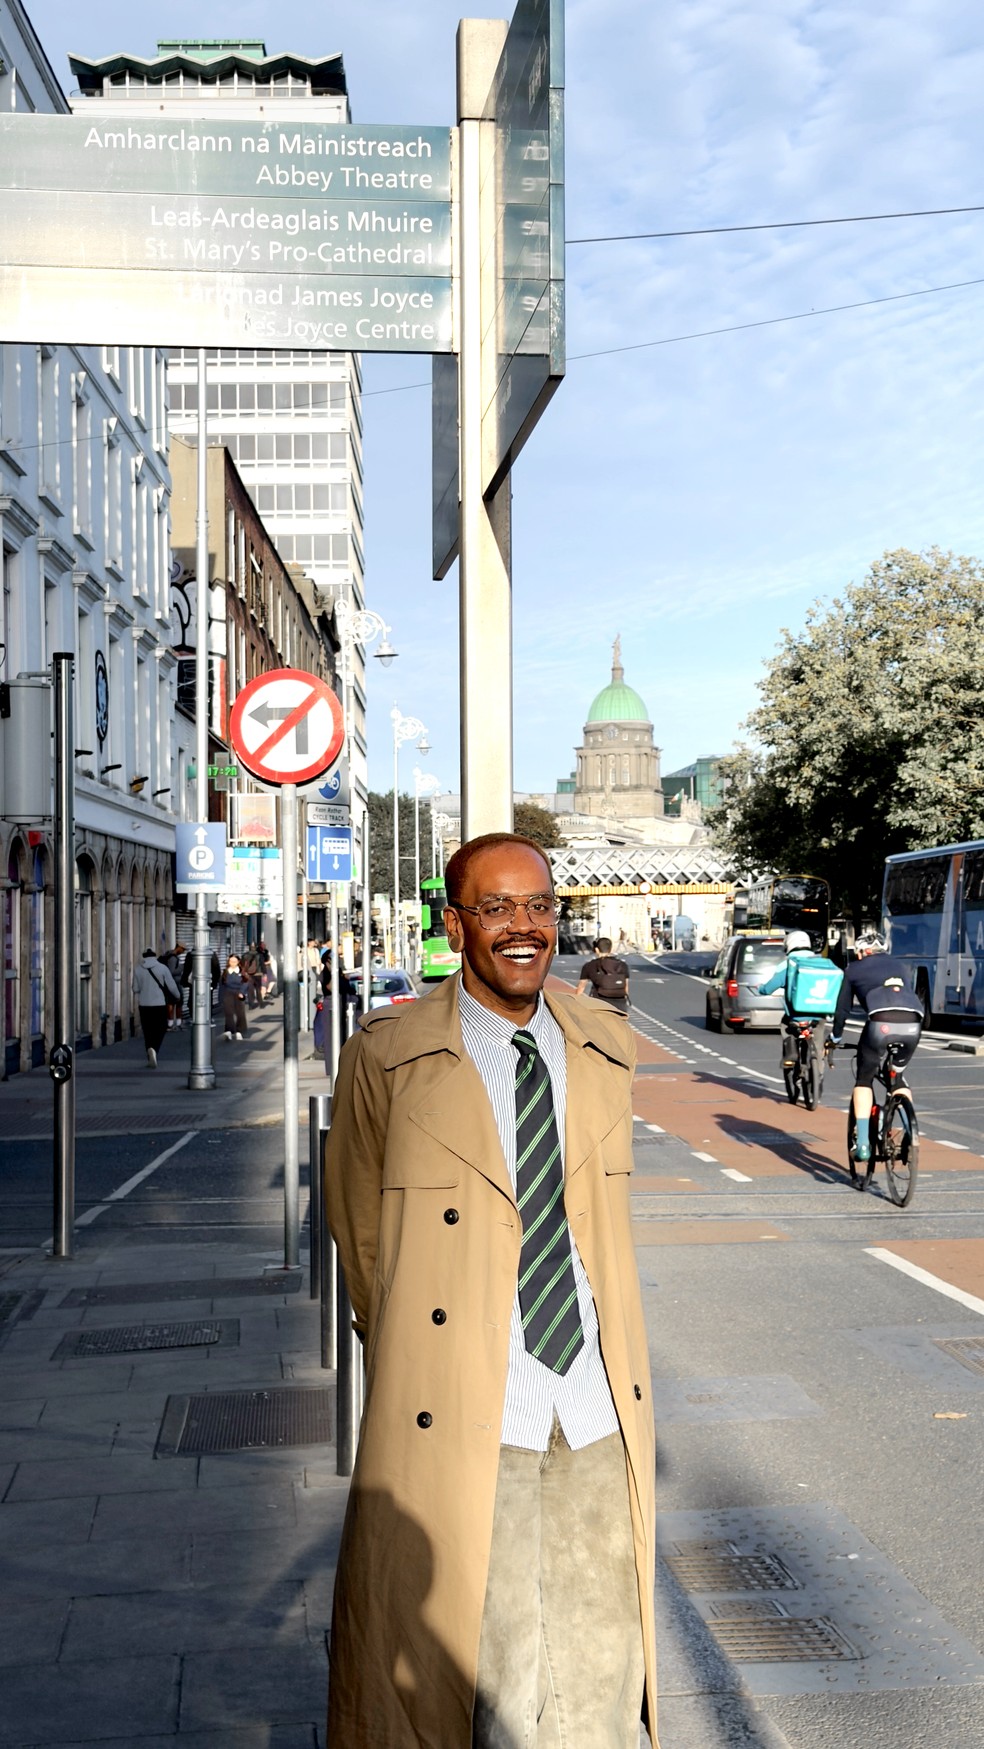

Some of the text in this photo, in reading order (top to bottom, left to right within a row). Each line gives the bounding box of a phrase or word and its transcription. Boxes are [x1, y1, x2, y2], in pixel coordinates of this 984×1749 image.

[84, 127, 432, 158] Amharclann na Mainistreach
[256, 164, 433, 192] Abbey Theatre
[151, 205, 433, 235] Leas-Ardeaglais Mhuire
[145, 237, 433, 265] St. Mary's Pro-Cathedral
[291, 285, 363, 307] James
[370, 287, 434, 313] Joyce
[284, 317, 348, 342] Joyce
[355, 319, 434, 340] Centre
[196, 850, 206, 865] P
[188, 872, 215, 880] PARKING
